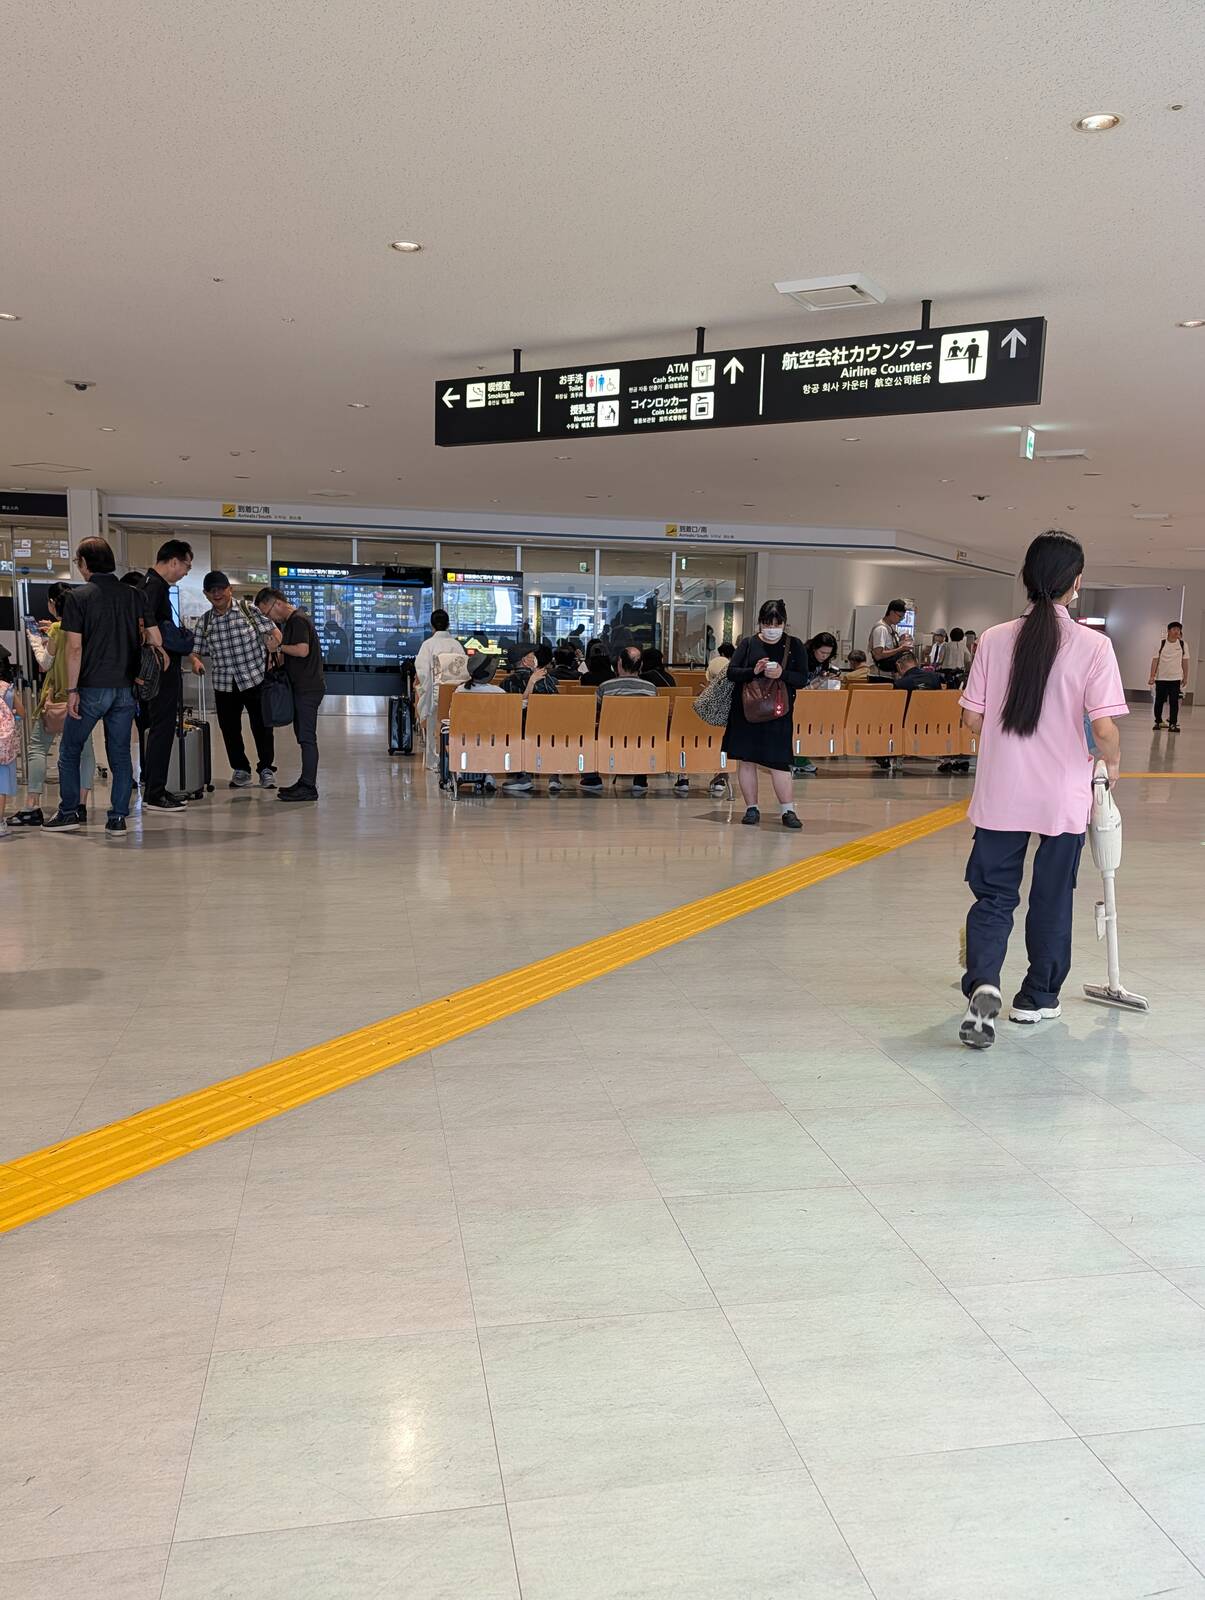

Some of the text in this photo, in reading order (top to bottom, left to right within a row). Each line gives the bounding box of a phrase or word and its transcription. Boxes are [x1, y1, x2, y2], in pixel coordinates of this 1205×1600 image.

[782, 340, 934, 370] 航空会社カウンター
[666, 362, 689, 374] ATM
[840, 361, 932, 378] Airline Counters
[559, 373, 583, 385] お手洗
[652, 376, 666, 384] Cash
[874, 373, 931, 388] 航空公司柜台
[802, 379, 868, 394] 항공 회사 카운터
[630, 395, 688, 409] コインロッカー
